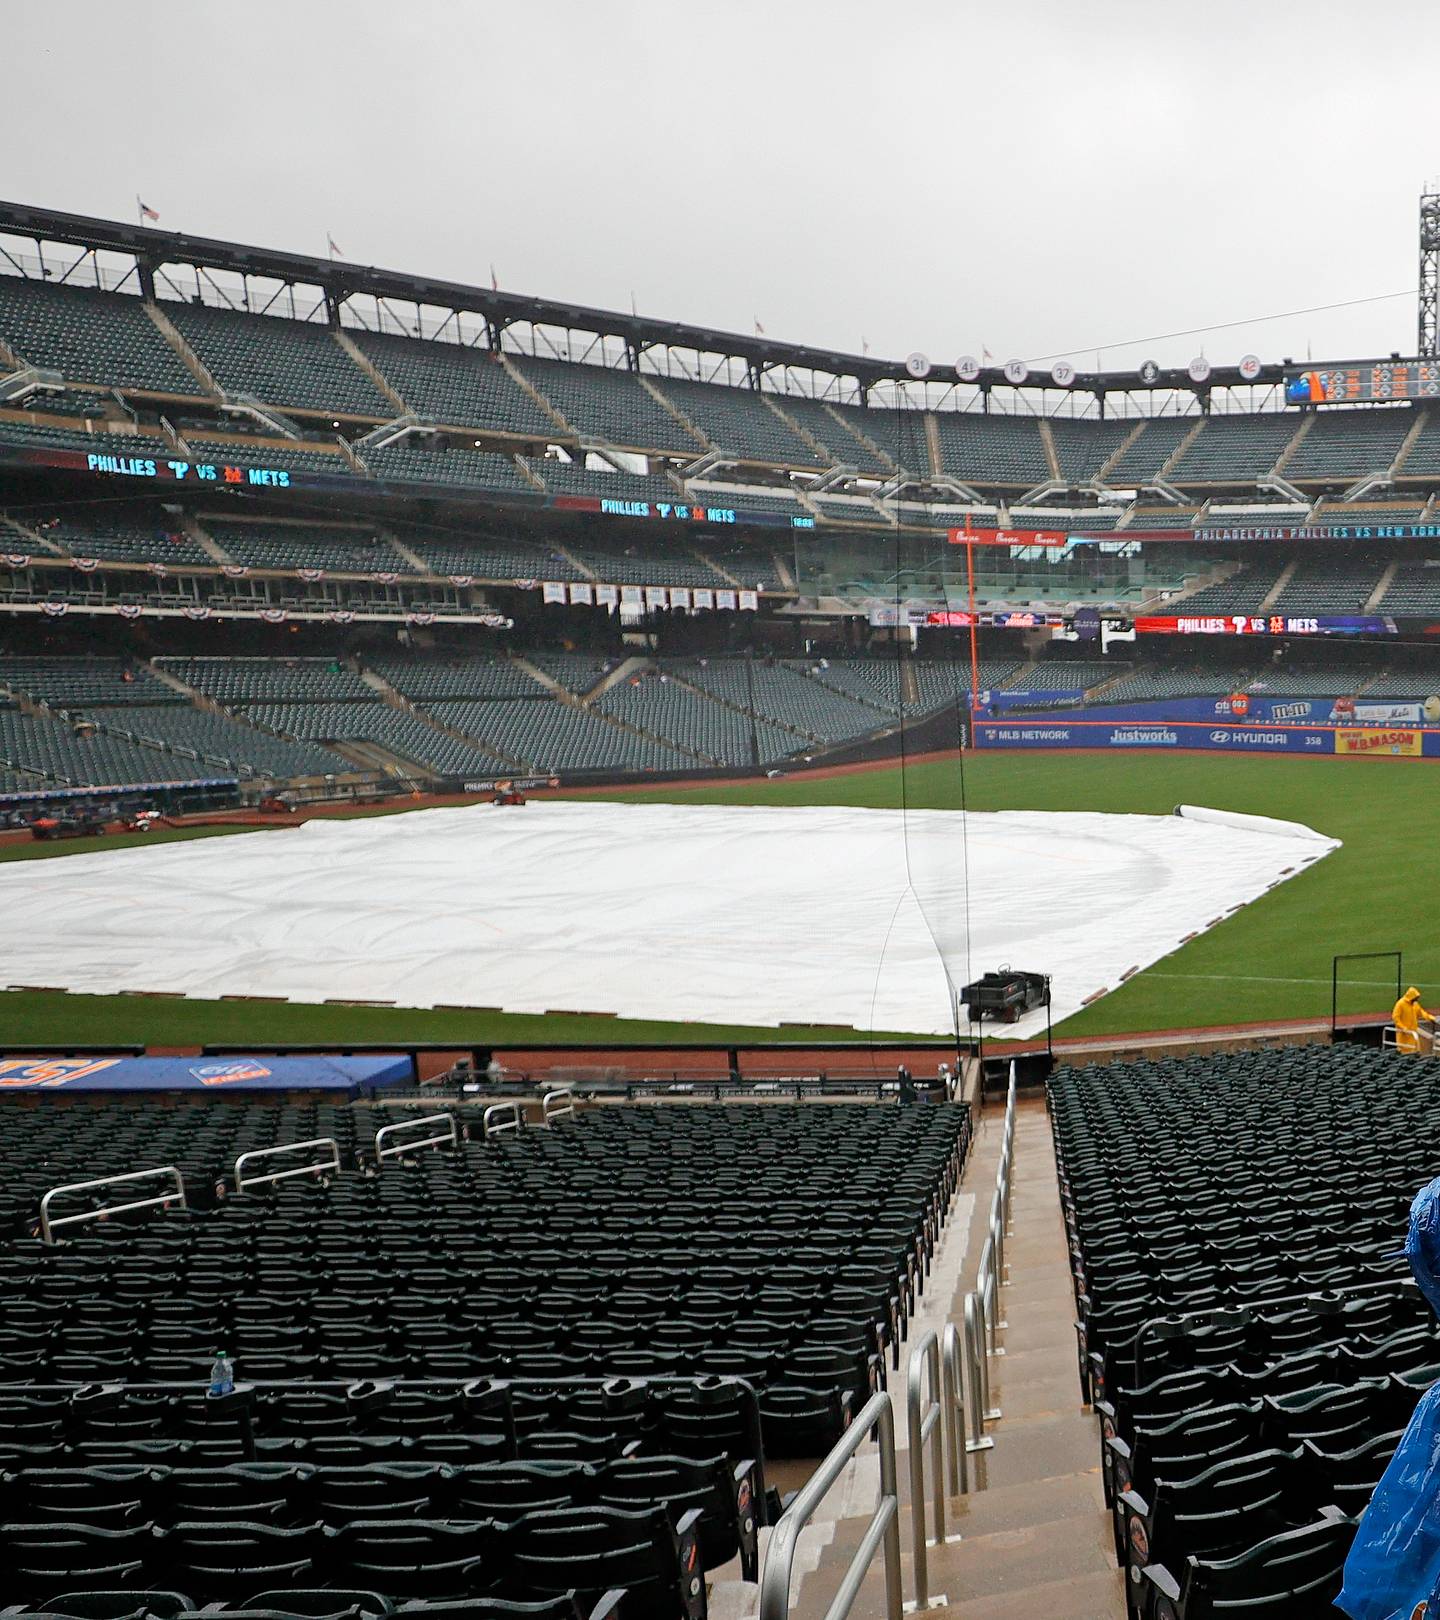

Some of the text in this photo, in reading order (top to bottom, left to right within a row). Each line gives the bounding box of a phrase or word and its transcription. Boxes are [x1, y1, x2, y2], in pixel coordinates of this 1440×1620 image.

[912, 360, 924, 371] 31
[962, 360, 973, 371] 41
[1011, 364, 1021, 376] 14
[1243, 360, 1256, 372] 42
[1057, 367, 1069, 379] 37
[87, 454, 156, 477] PHILLIES
[196, 464, 217, 480] VS
[249, 469, 290, 488] METS
[602, 499, 650, 517] PHILLIES
[674, 505, 688, 519] VS
[707, 508, 736, 524] METS
[1194, 528, 1284, 541] PHILADELPHIA
[1290, 527, 1348, 540] PHILLIES
[1354, 526, 1372, 537] VS
[1377, 526, 1405, 537] NEW
[1177, 618, 1225, 633] PHILLIES
[1250, 618, 1265, 631] VS
[1287, 618, 1318, 633] METS
[998, 730, 1070, 740] MLB NETWORK
[1110, 730, 1176, 742] Justworks
[1233, 734, 1287, 744] HYUNDAI
[1305, 736, 1322, 745] 358
